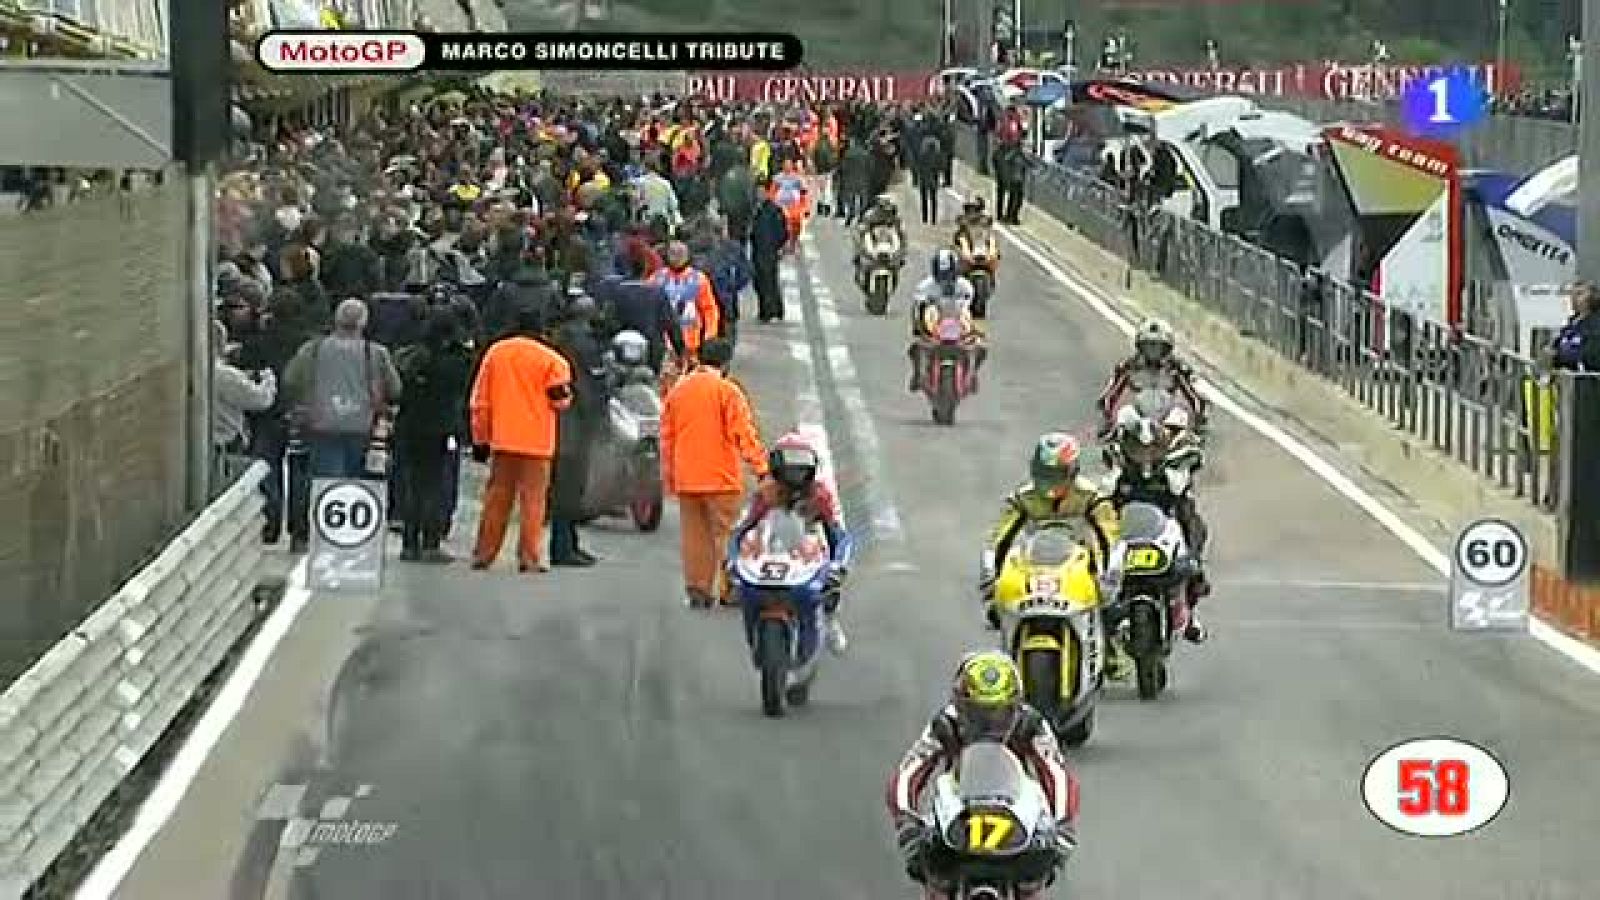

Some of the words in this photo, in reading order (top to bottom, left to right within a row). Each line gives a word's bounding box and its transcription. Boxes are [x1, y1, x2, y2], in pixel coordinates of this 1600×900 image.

[323, 499, 372, 530] 60
[1466, 539, 1517, 568] 60
[966, 814, 1012, 850] 17
